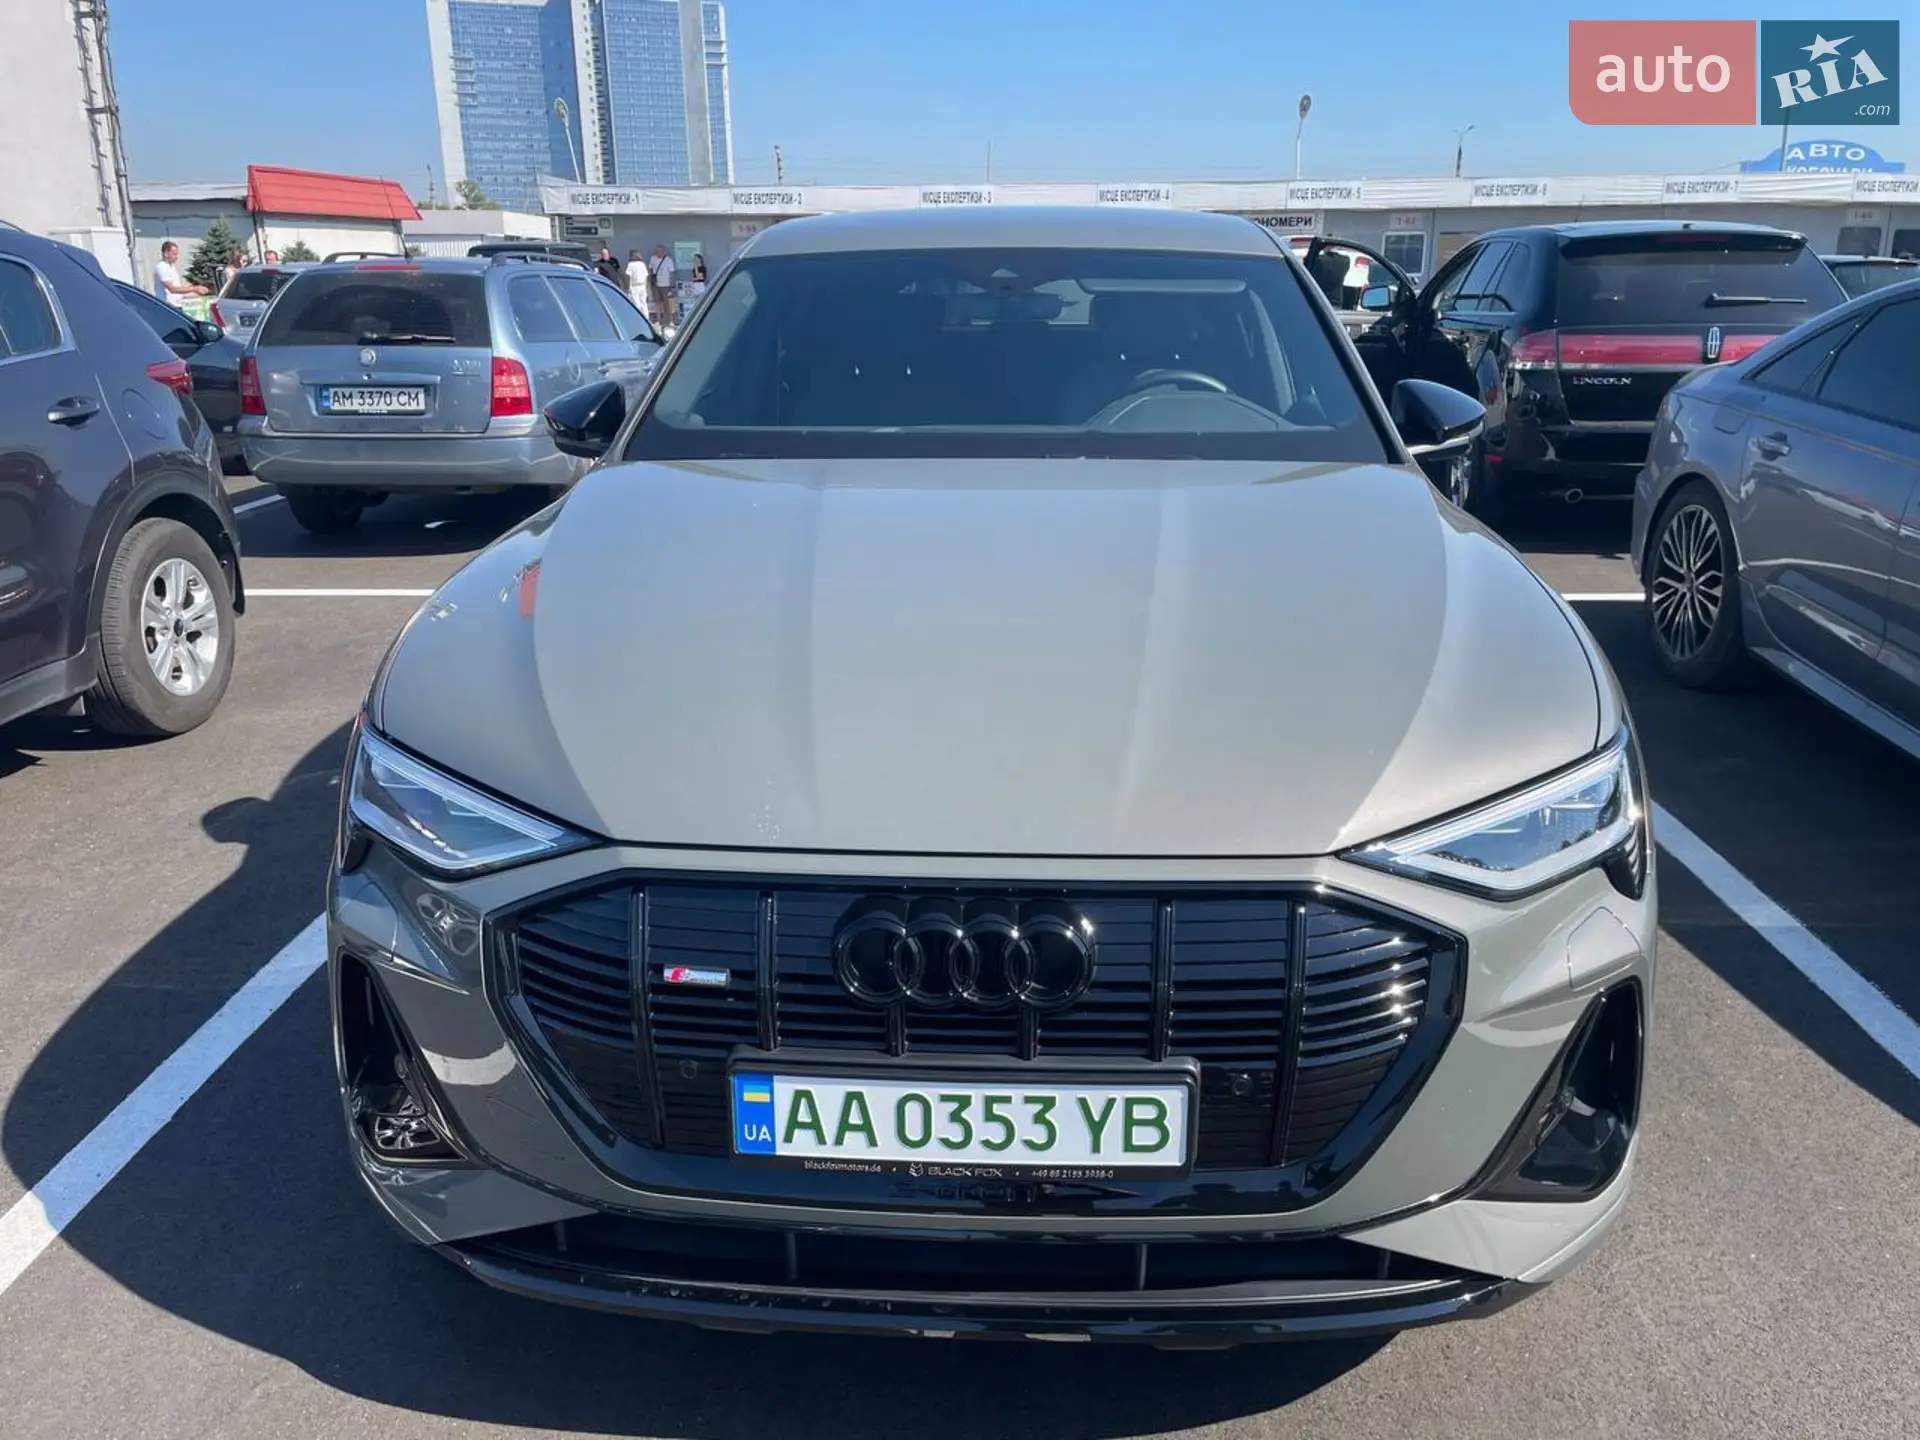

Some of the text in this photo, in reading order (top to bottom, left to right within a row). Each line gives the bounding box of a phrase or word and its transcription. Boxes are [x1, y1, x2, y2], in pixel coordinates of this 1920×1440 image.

[1787, 143, 1865, 161] АВТО
[1572, 376, 1632, 385] LINCOLN
[332, 390, 420, 407] AM 3370 CM
[783, 1088, 1171, 1155] AA 0353 YB
[744, 1123, 772, 1143] UA
[928, 1165, 1003, 1177] BLACK FOX
